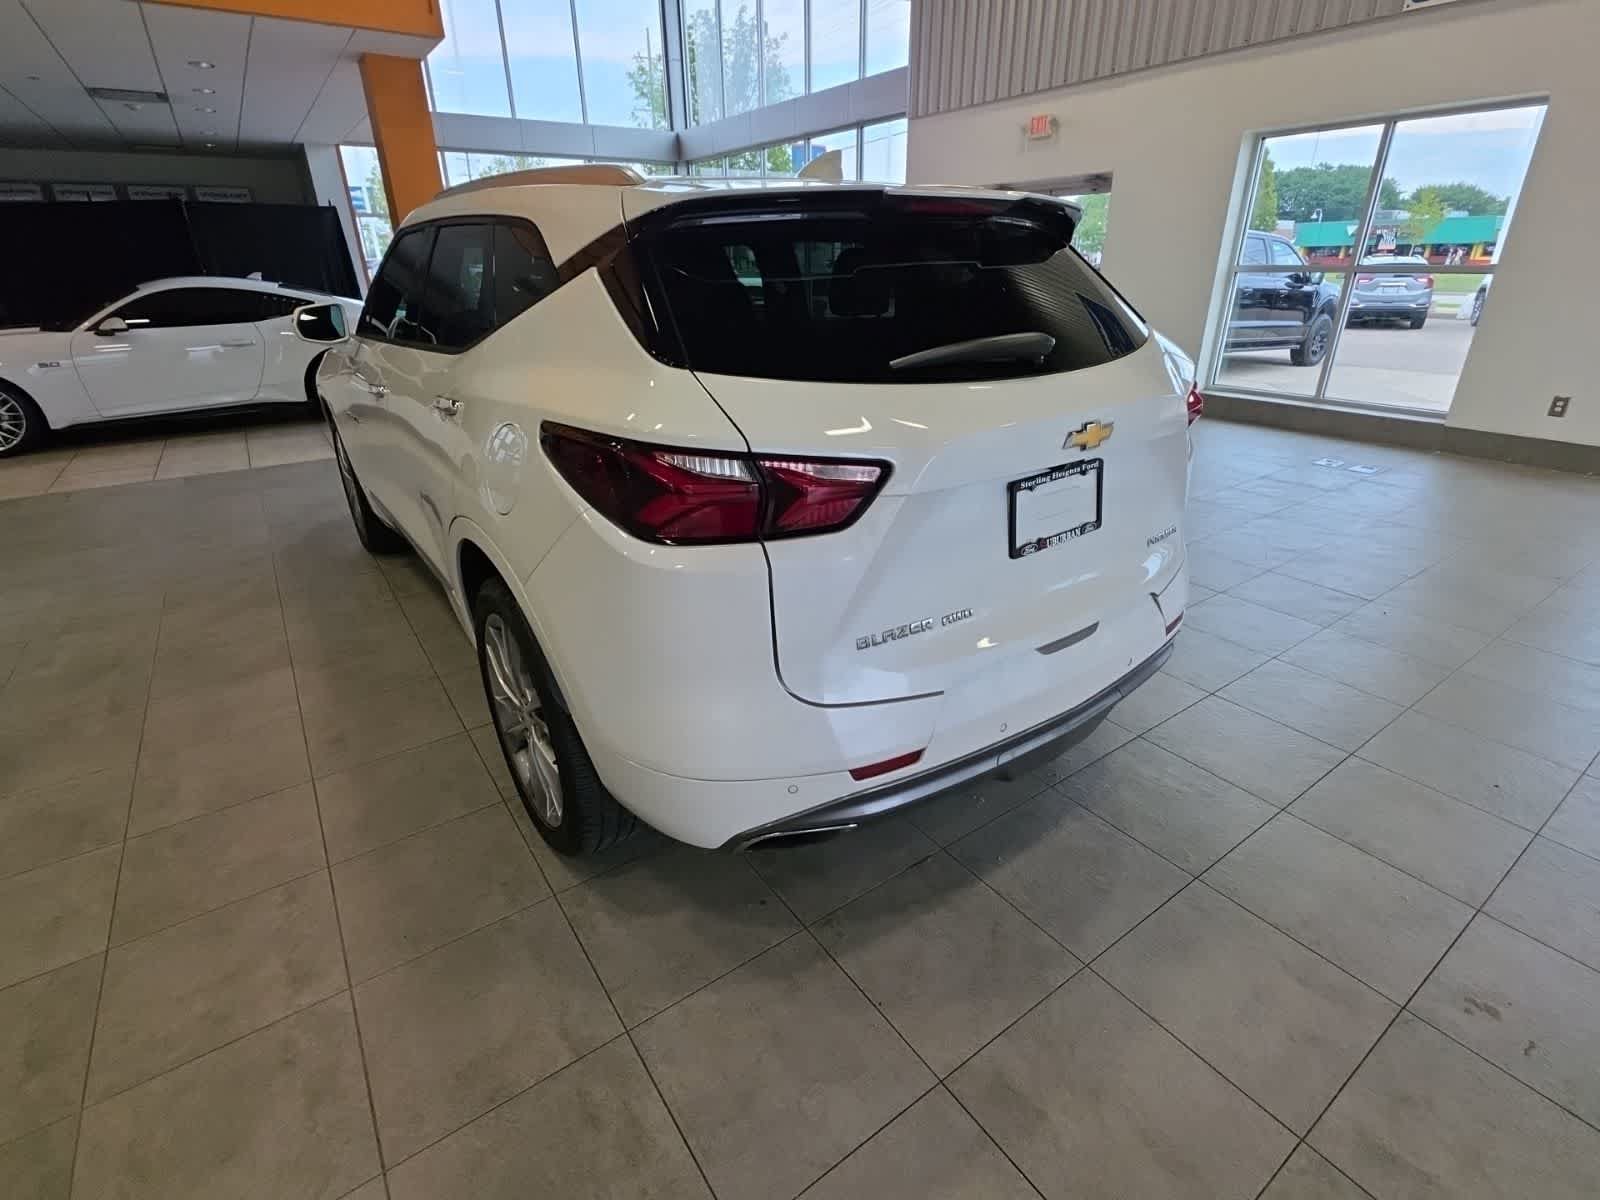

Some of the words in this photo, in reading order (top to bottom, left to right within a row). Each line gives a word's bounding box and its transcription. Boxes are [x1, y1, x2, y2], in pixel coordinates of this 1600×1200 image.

[1020, 474, 1051, 489] Sterling
[1052, 466, 1080, 480] Heights
[1082, 460, 1099, 471] Ford
[856, 618, 933, 651] BLAZER
